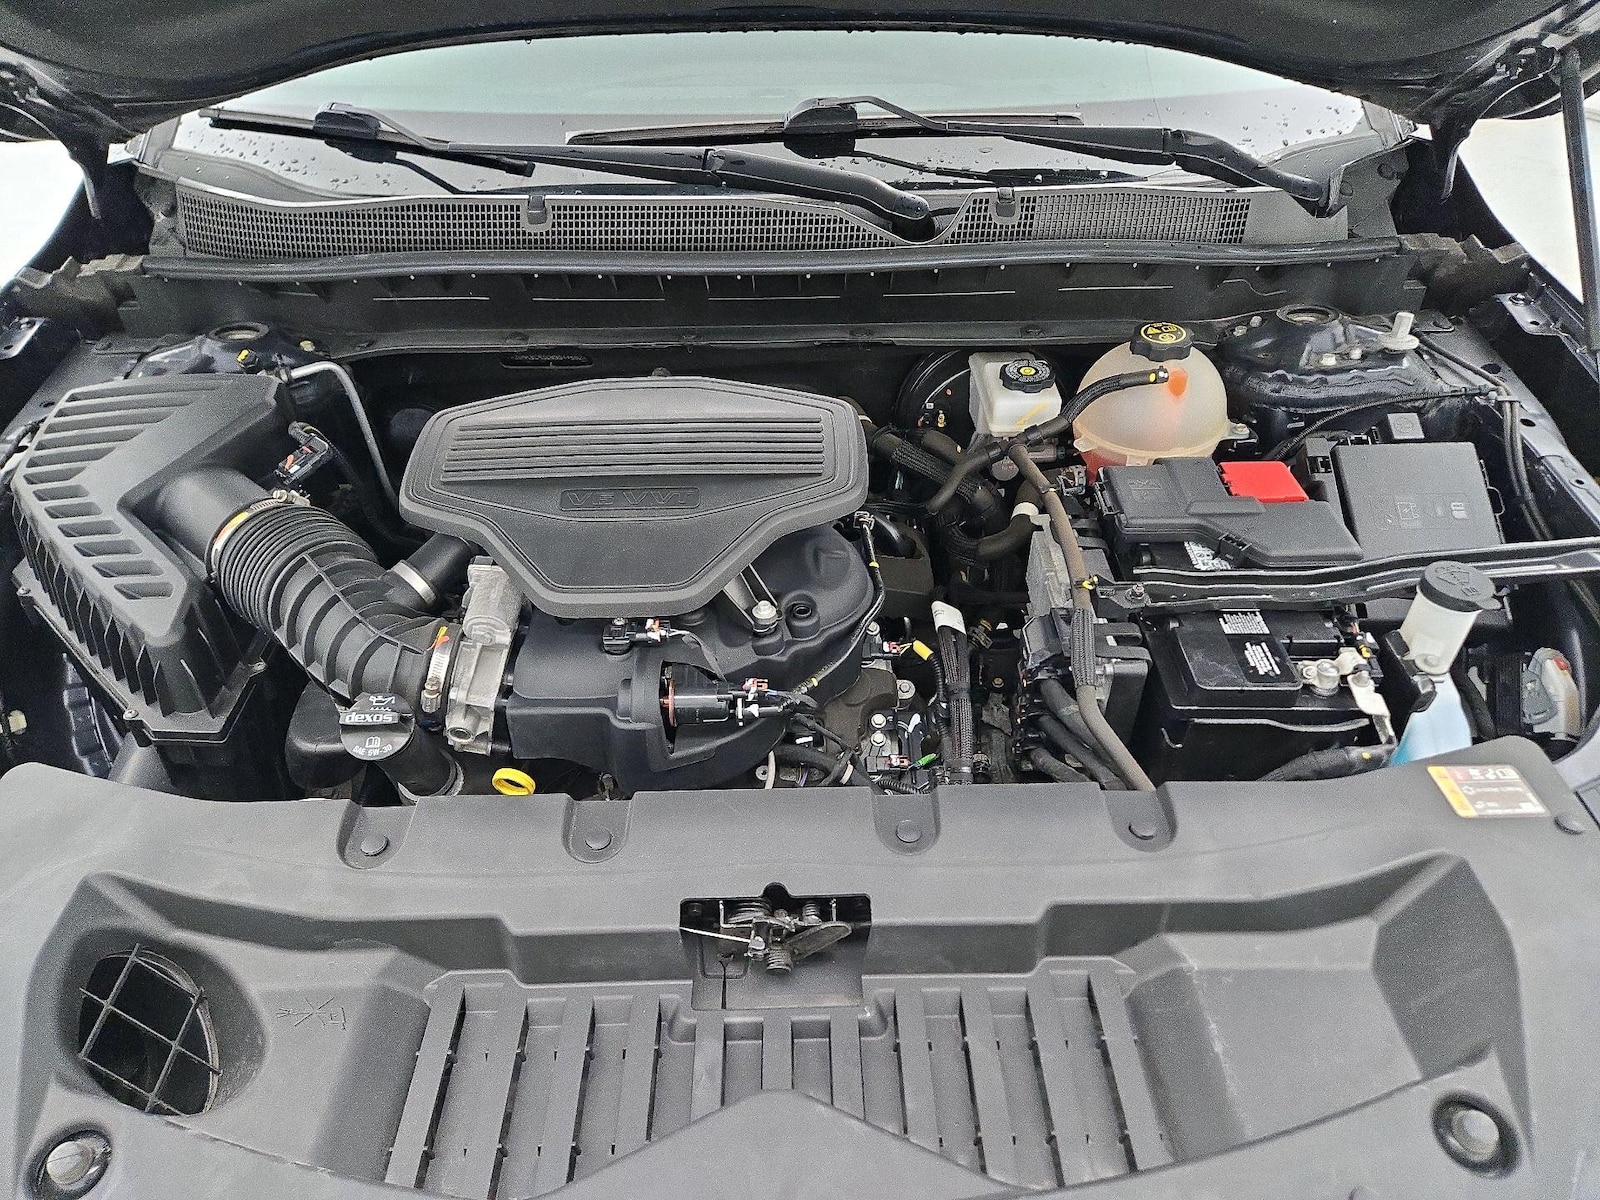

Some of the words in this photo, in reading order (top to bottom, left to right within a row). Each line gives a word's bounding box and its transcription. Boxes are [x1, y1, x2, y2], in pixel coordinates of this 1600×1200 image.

[622, 490, 695, 505] VVT
[345, 712, 393, 723] dexos
[353, 745, 366, 756] SAE
[367, 743, 393, 757] 5W-30
